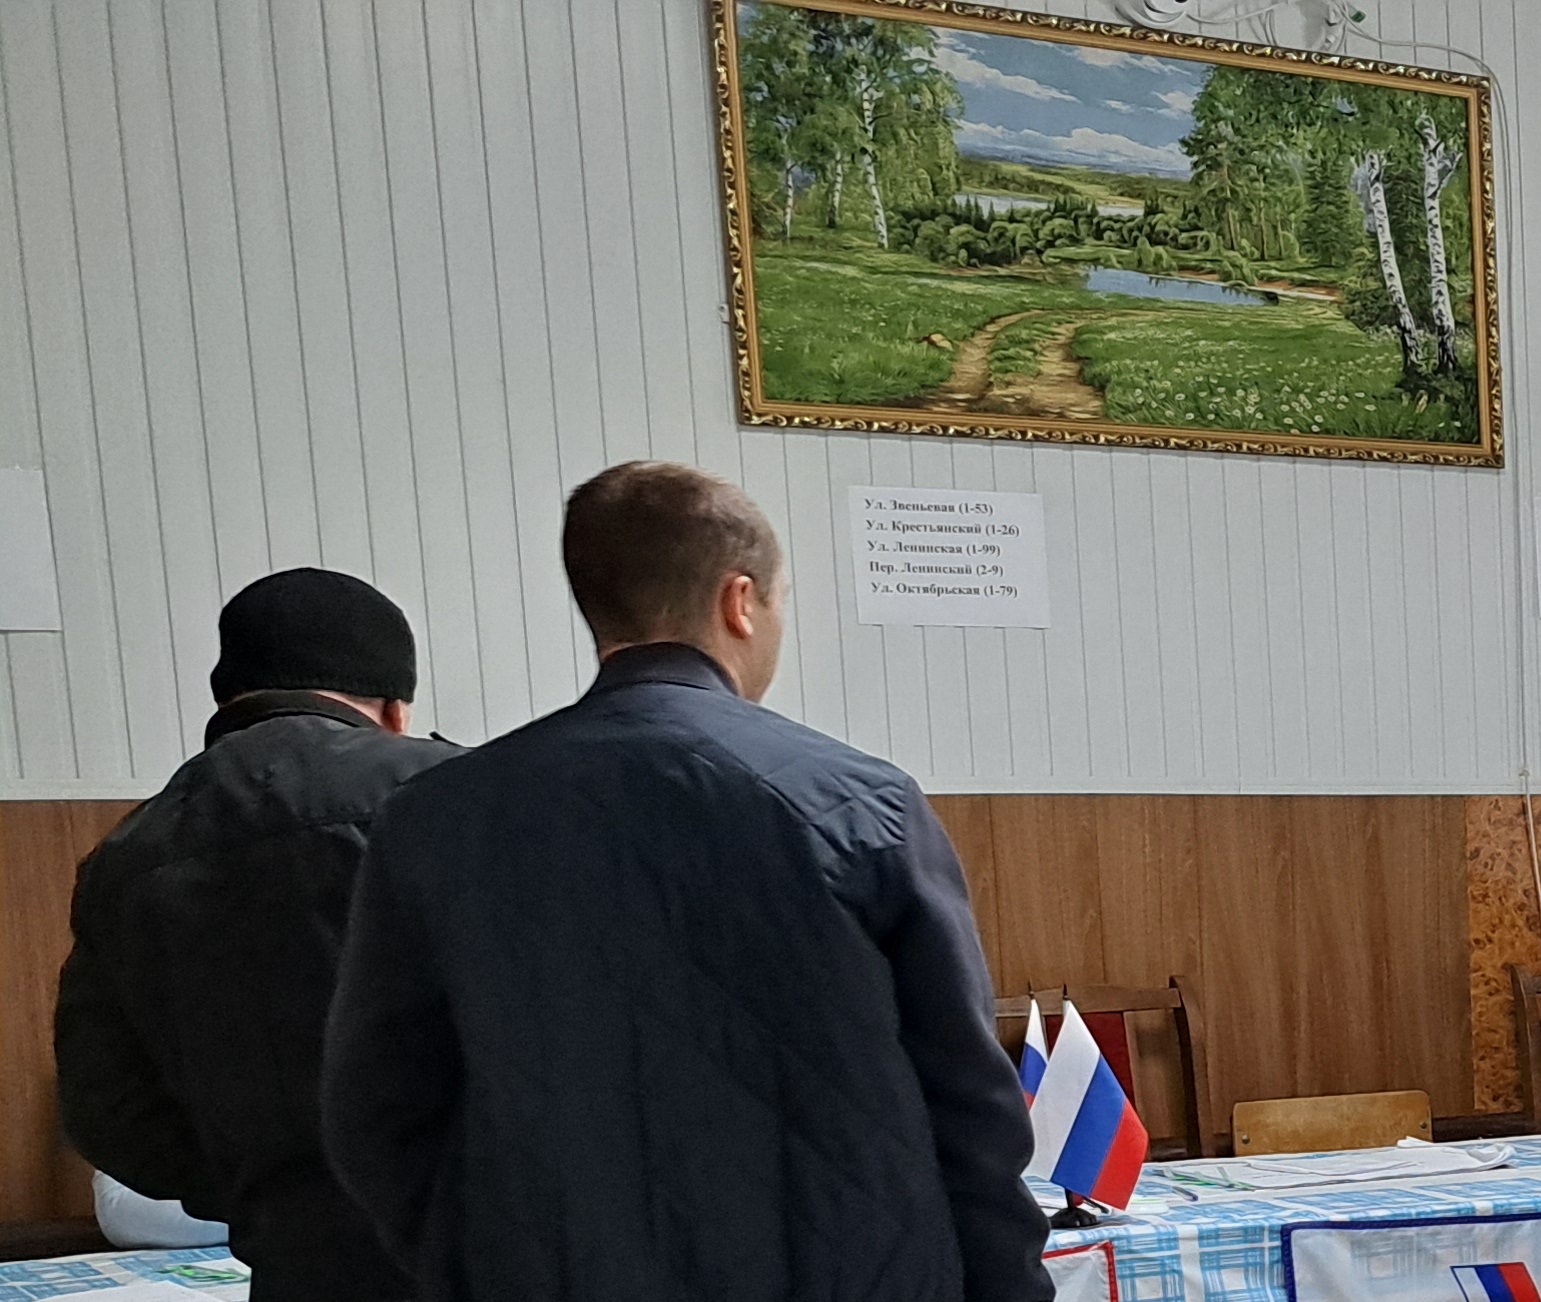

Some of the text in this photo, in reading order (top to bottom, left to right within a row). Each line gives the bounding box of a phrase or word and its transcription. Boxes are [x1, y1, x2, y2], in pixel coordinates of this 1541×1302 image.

[864, 499, 993, 515] Ул. Звеньевая (1-53)
[866, 520, 1020, 537] Ул. Крестьянский (1-26)
[867, 540, 1001, 556] Ул. Ленинская (1-99)
[870, 561, 1004, 577] Пер. Ленинский (2-9)
[871, 582, 1018, 599] Ул. Октябрьская (1-79)
